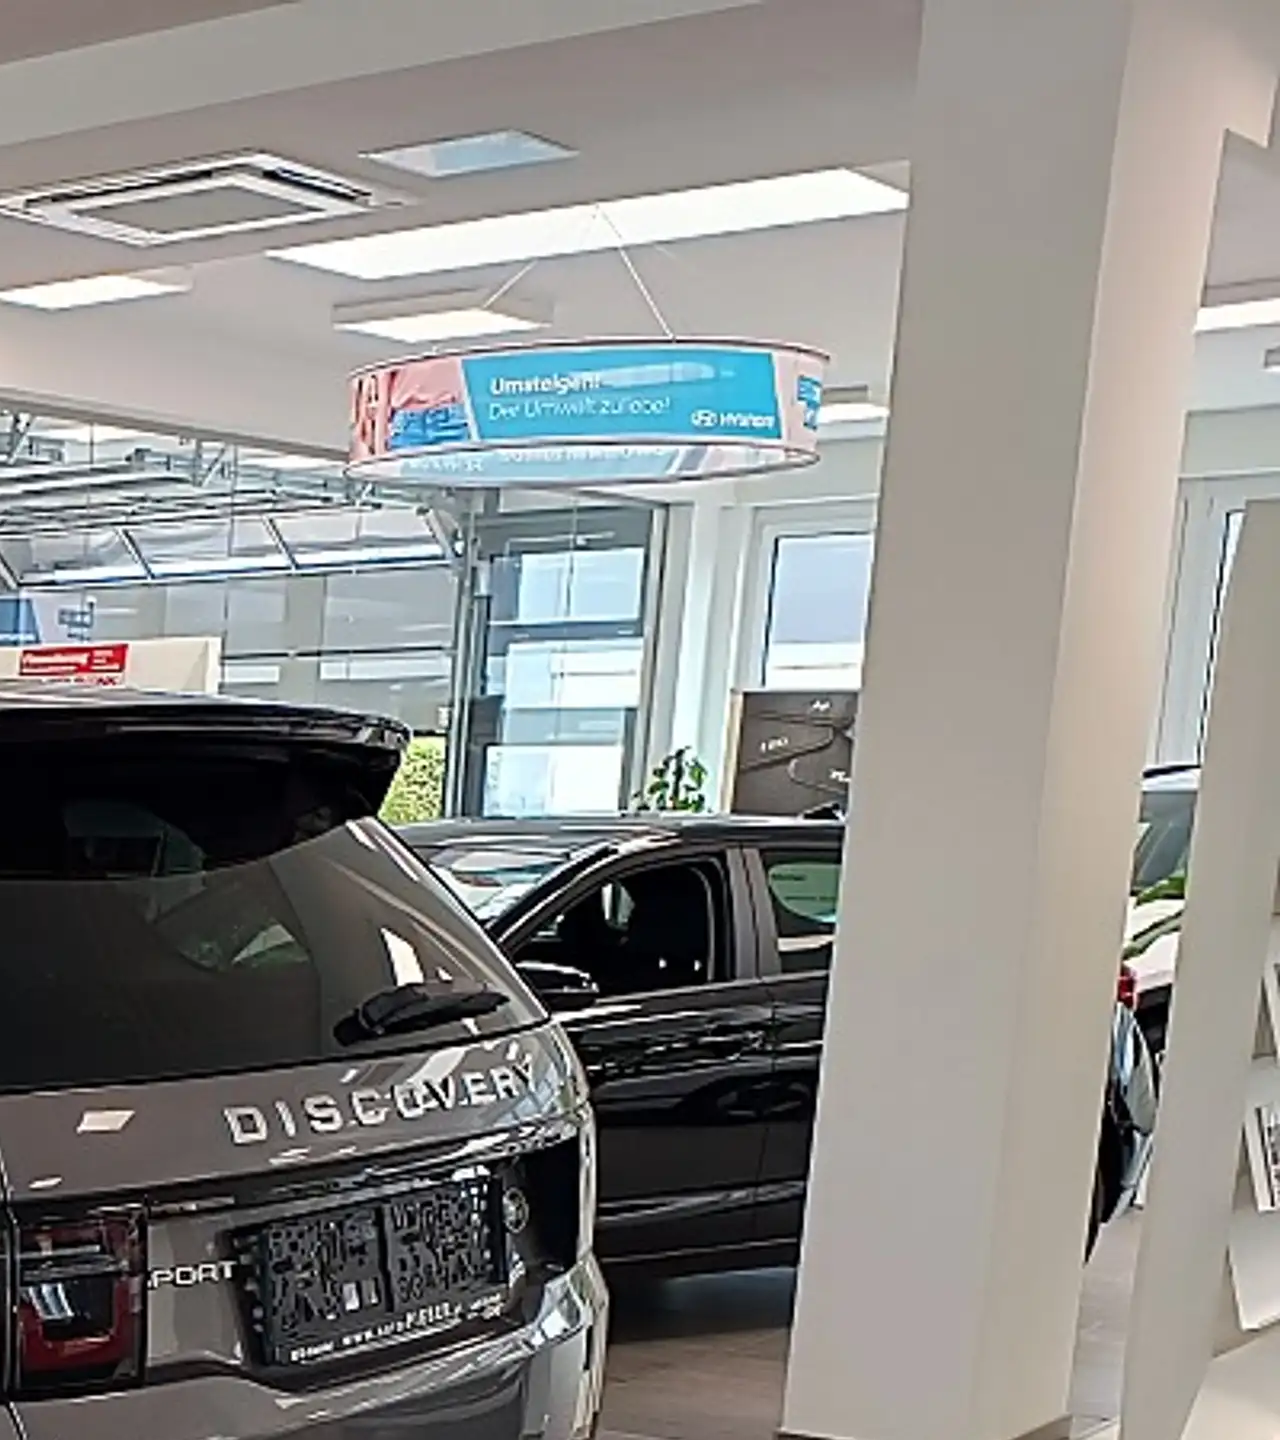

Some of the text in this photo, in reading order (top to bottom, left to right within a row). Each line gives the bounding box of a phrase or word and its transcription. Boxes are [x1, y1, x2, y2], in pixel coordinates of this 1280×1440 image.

[490, 372, 602, 396] Umsteigen!
[490, 401, 520, 421] Der
[223, 1054, 536, 1146] DISCOVERY
[147, 1260, 237, 1290] PORT
